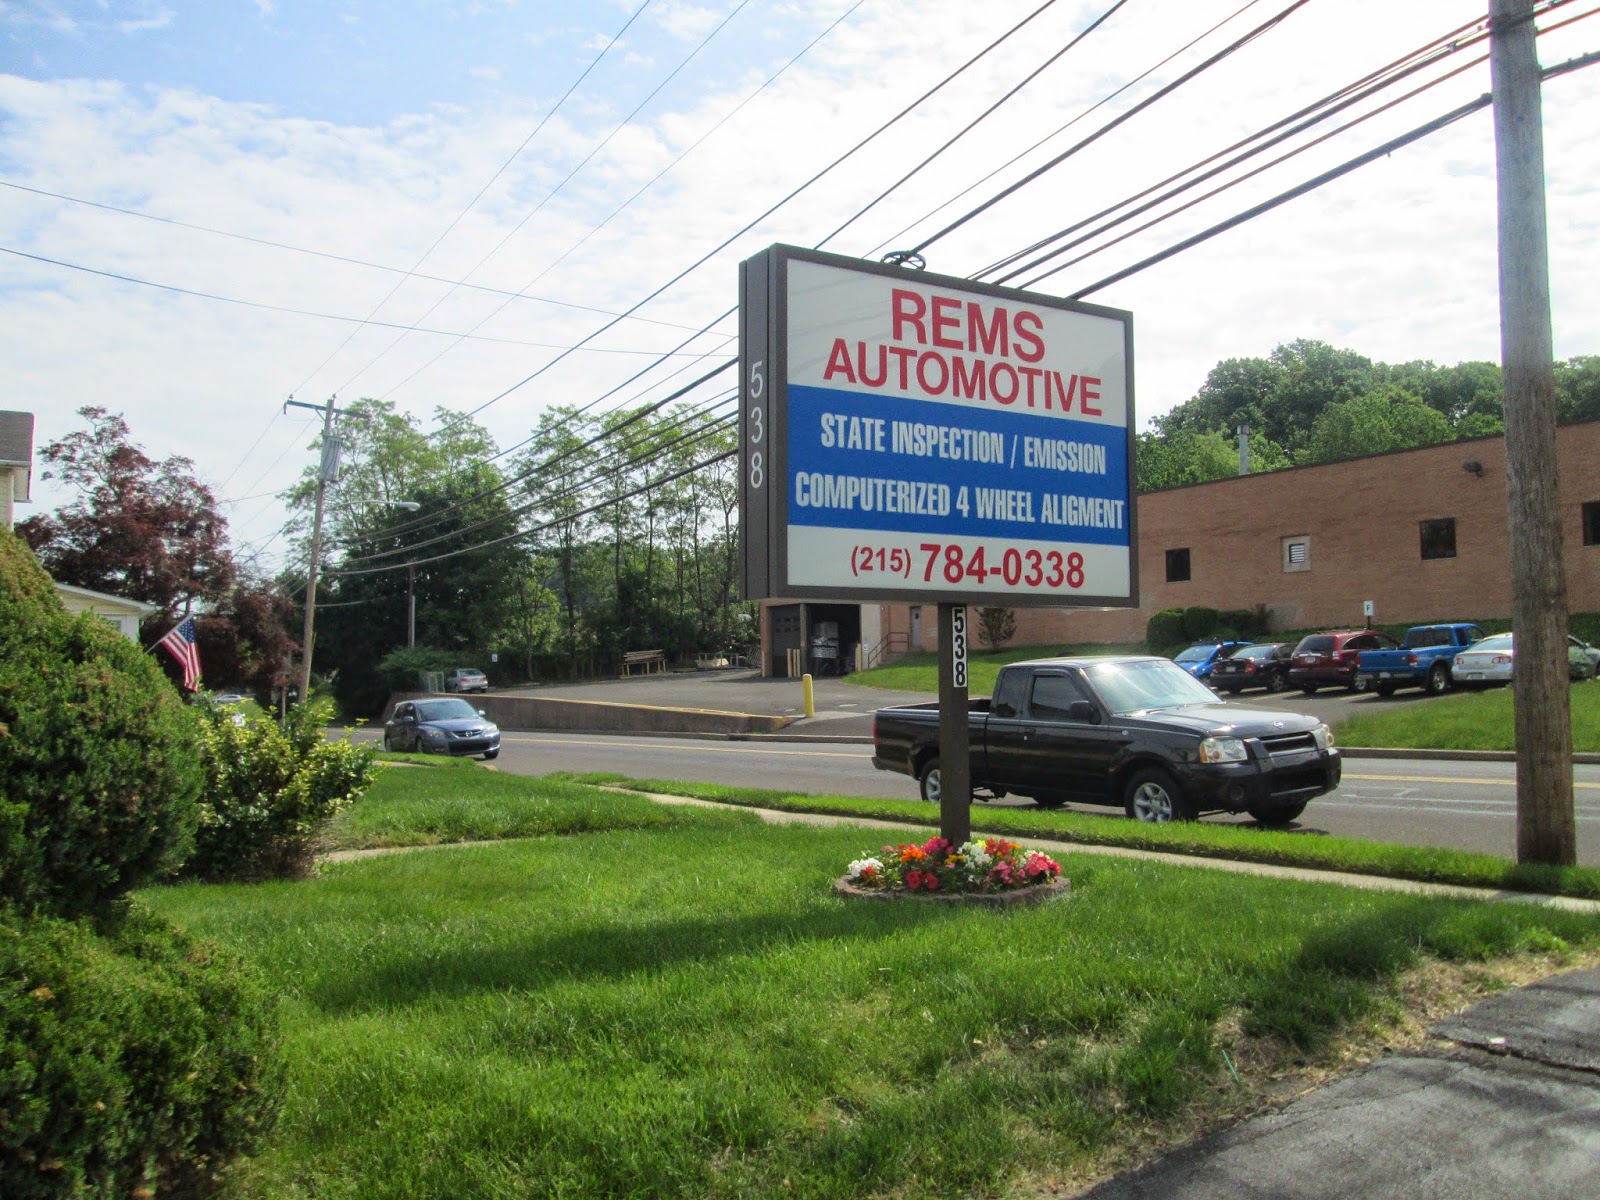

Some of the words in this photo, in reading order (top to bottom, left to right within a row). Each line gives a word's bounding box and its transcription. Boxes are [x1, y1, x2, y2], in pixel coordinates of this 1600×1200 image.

[891, 288, 1046, 364] REMS
[822, 337, 1103, 416] AUTOMOTIVE
[821, 412, 885, 453] STATE
[892, 421, 1004, 464] INSPECTION
[1009, 434, 1018, 469] /
[1024, 436, 1106, 475] EMISSION
[795, 471, 951, 517] COMPUTERIZED
[956, 486, 970, 519] 4
[975, 487, 1035, 524] WHEEL
[1040, 491, 1124, 530] ALIGMENT
[850, 545, 911, 578] (215)
[919, 542, 1085, 589] 784-0338
